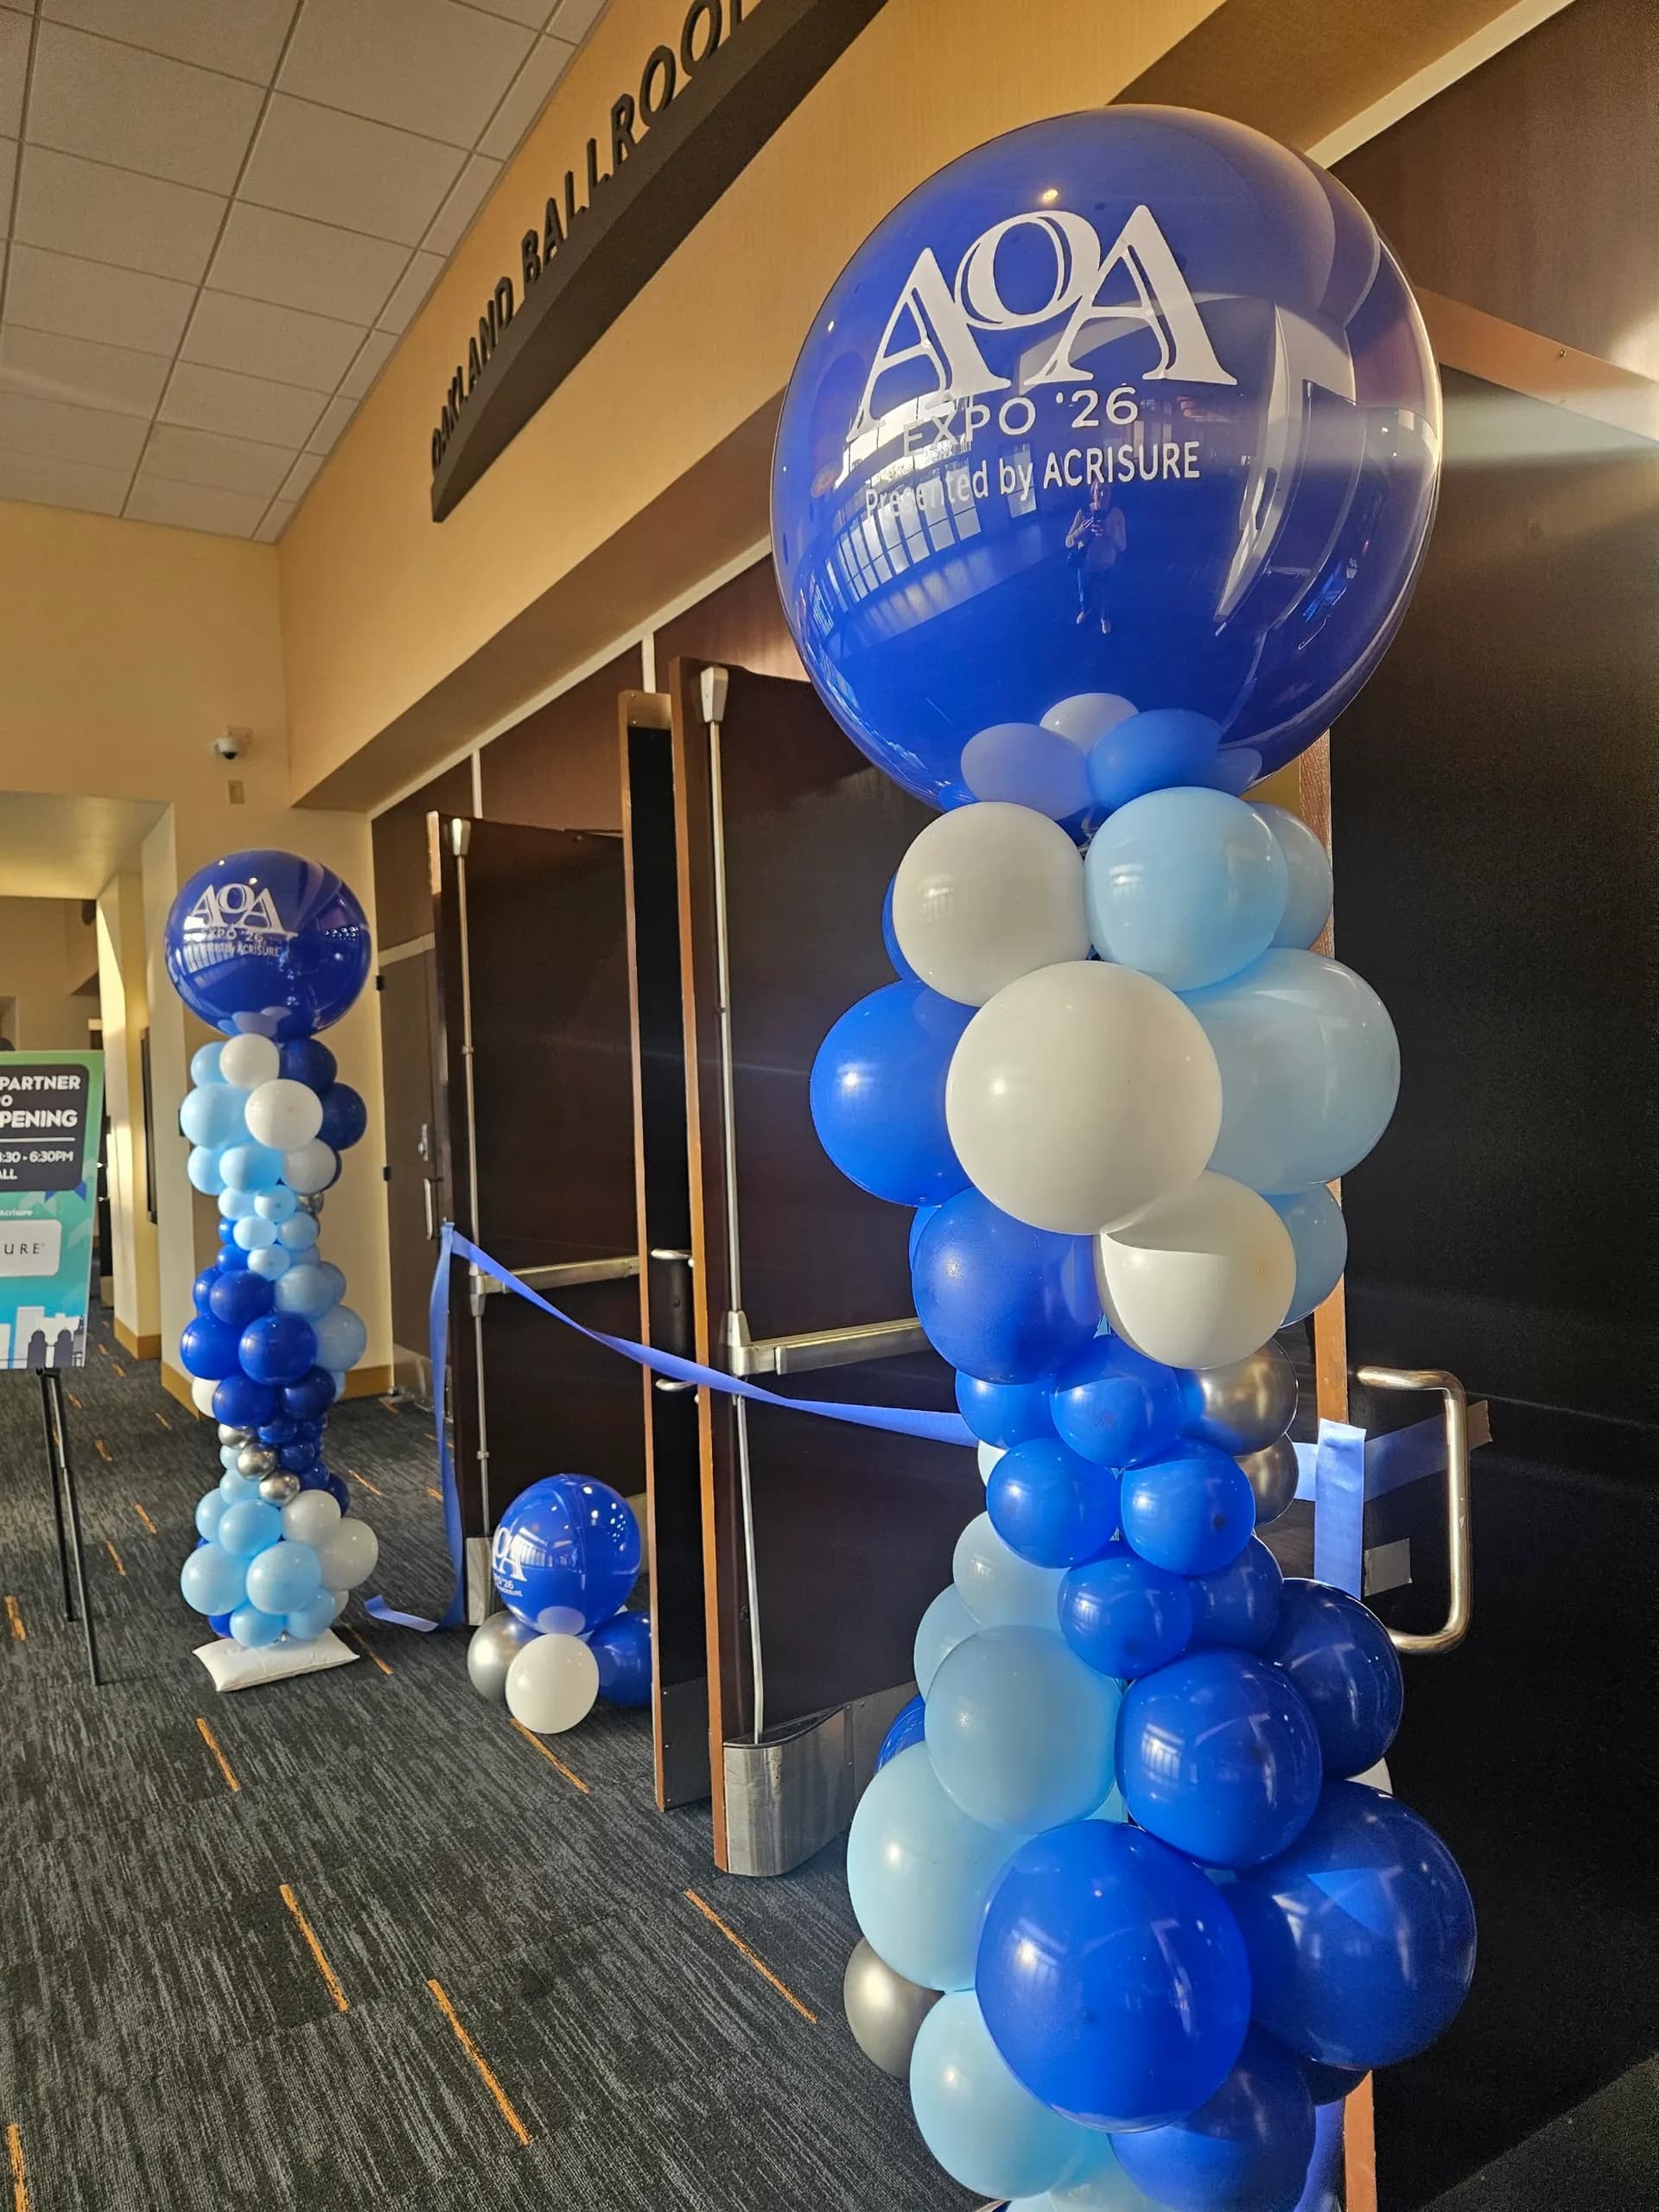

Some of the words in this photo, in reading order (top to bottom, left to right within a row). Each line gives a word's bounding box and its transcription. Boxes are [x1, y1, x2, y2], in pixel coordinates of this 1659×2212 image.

[432, 276, 513, 471] OAKLAND
[521, 0, 741, 285] BALLROO
[847, 205, 1237, 442] AOA
[903, 397, 1036, 456] EXPO
[865, 460, 988, 517] Presented
[999, 458, 1033, 501] by
[1043, 441, 1200, 490] ACRISURE
[184, 883, 296, 937] AOA
[202, 924, 237, 941] XPO
[0, 1075, 81, 1091] PARTNER
[29, 1150, 74, 1163] 6:30PM
